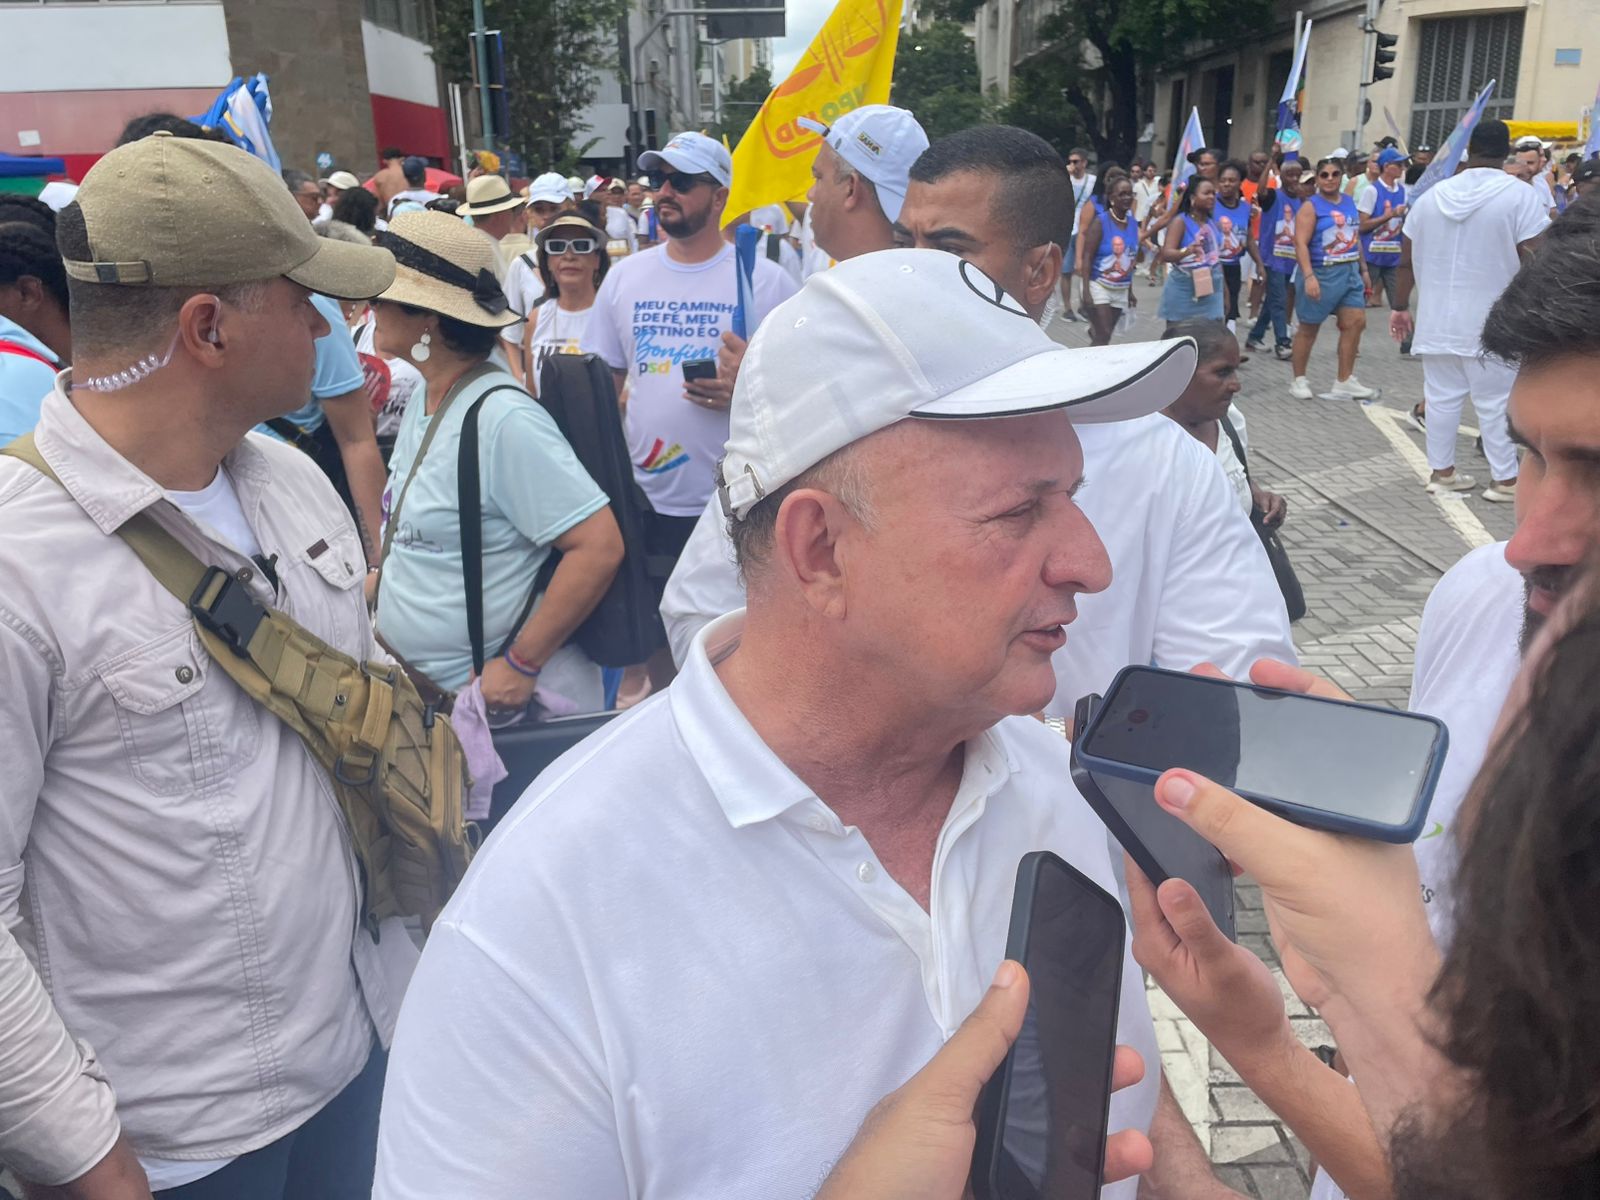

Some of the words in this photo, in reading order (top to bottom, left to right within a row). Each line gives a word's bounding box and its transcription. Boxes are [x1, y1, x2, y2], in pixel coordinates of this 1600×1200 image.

[634, 301, 665, 311] MEU
[642, 312, 660, 323] DE
[685, 313, 719, 325] MEU
[633, 325, 695, 337] DESTINO
[708, 327, 720, 338] O
[636, 328, 718, 366] Bonfim
[639, 360, 672, 377] psd
